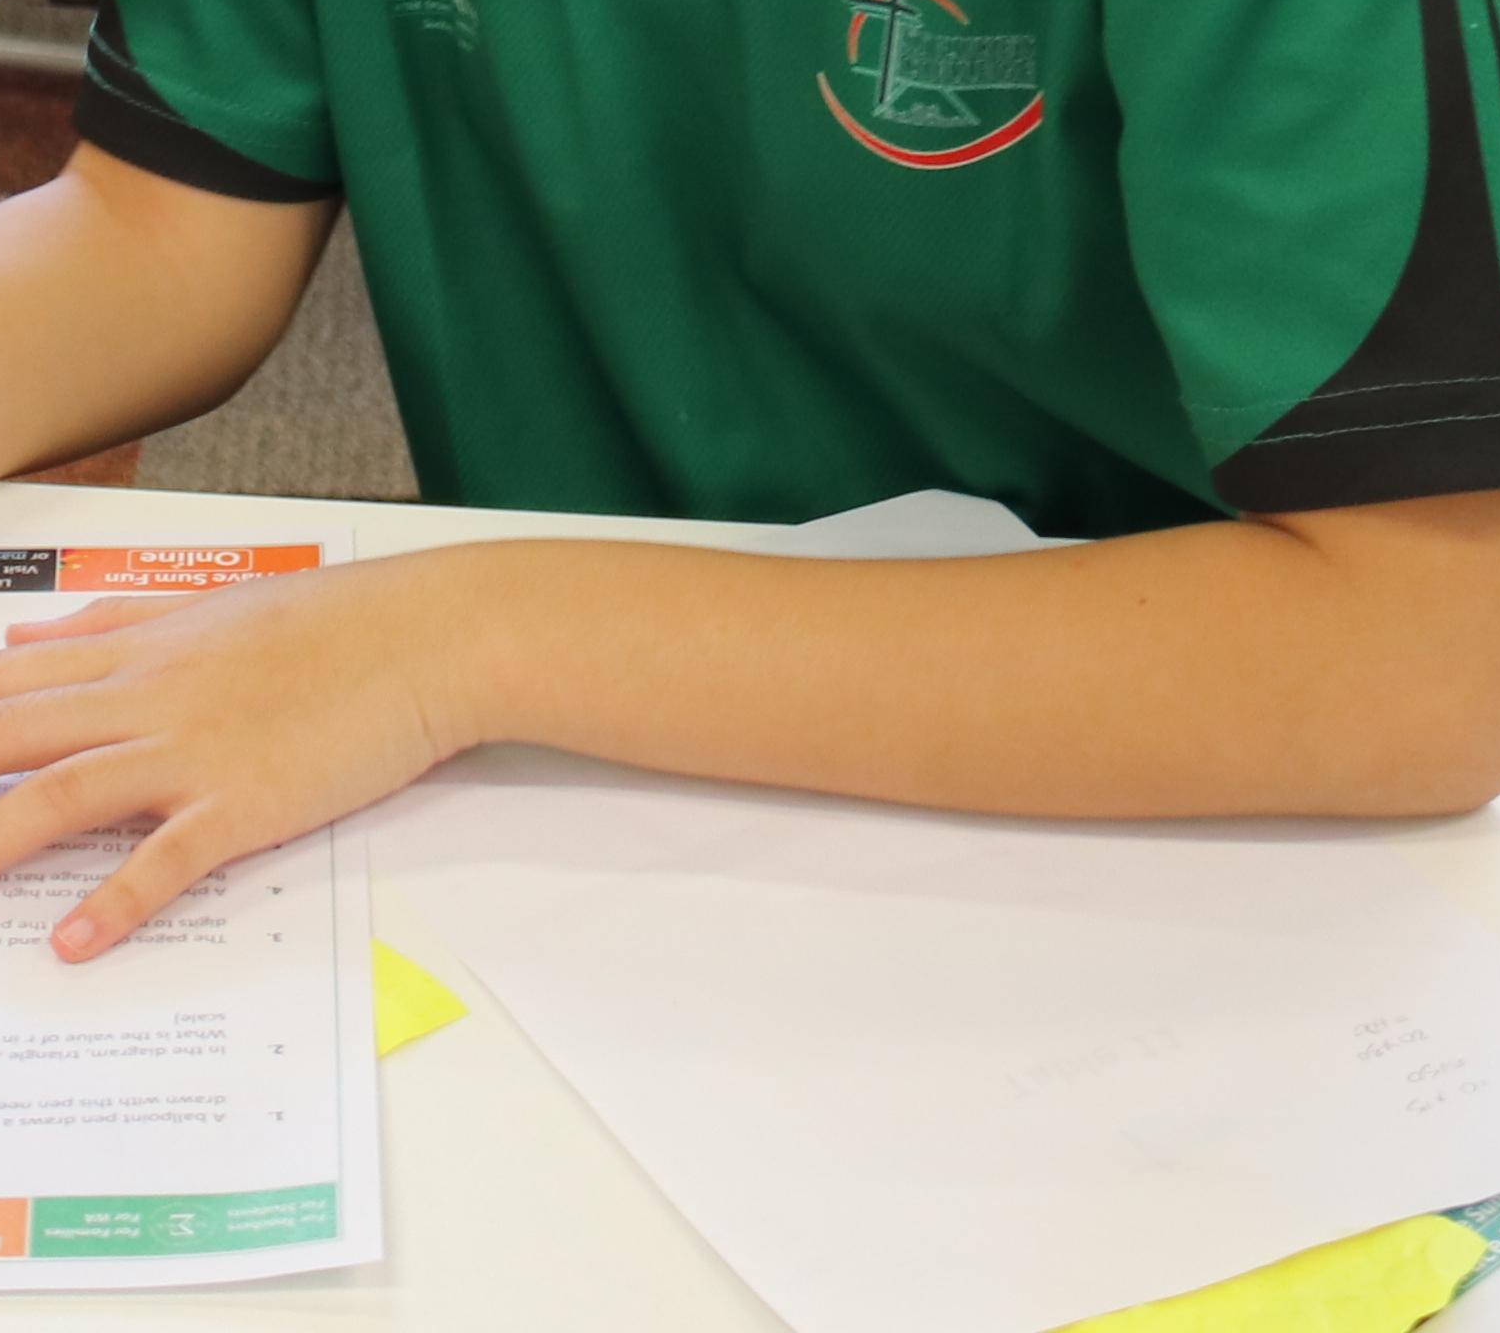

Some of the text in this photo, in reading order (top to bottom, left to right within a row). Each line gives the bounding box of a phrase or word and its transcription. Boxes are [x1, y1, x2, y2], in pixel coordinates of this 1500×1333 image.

[137, 550, 240, 567] Online
[3, 566, 38, 574] Visit
[105, 571, 149, 585] Fun
[153, 571, 209, 585] Sum
[1, 885, 40, 898] high
[18, 921, 47, 930] the
[153, 918, 172, 927] to
[177, 914, 226, 927] digits
[8, 937, 42, 946] and
[135, 930, 187, 943] pages
[193, 935, 226, 943] The
[40, 1034, 59, 1045] of
[66, 1034, 114, 1043] value
[121, 1032, 150, 1041] the
[176, 1030, 226, 1039] What
[9, 1050, 79, 1061] triangle
[86, 1046, 168, 1057] diagram,
[173, 1047, 203, 1055] the
[209, 1046, 226, 1055] In
[38, 1098, 74, 1108] pen
[80, 1098, 112, 1108] this
[119, 1097, 160, 1107] with
[166, 1096, 226, 1105] drawn
[19, 1117, 76, 1125] draws
[82, 1113, 117, 1123] pen
[125, 1111, 206, 1126] ballpoint
[213, 1114, 225, 1122] A
